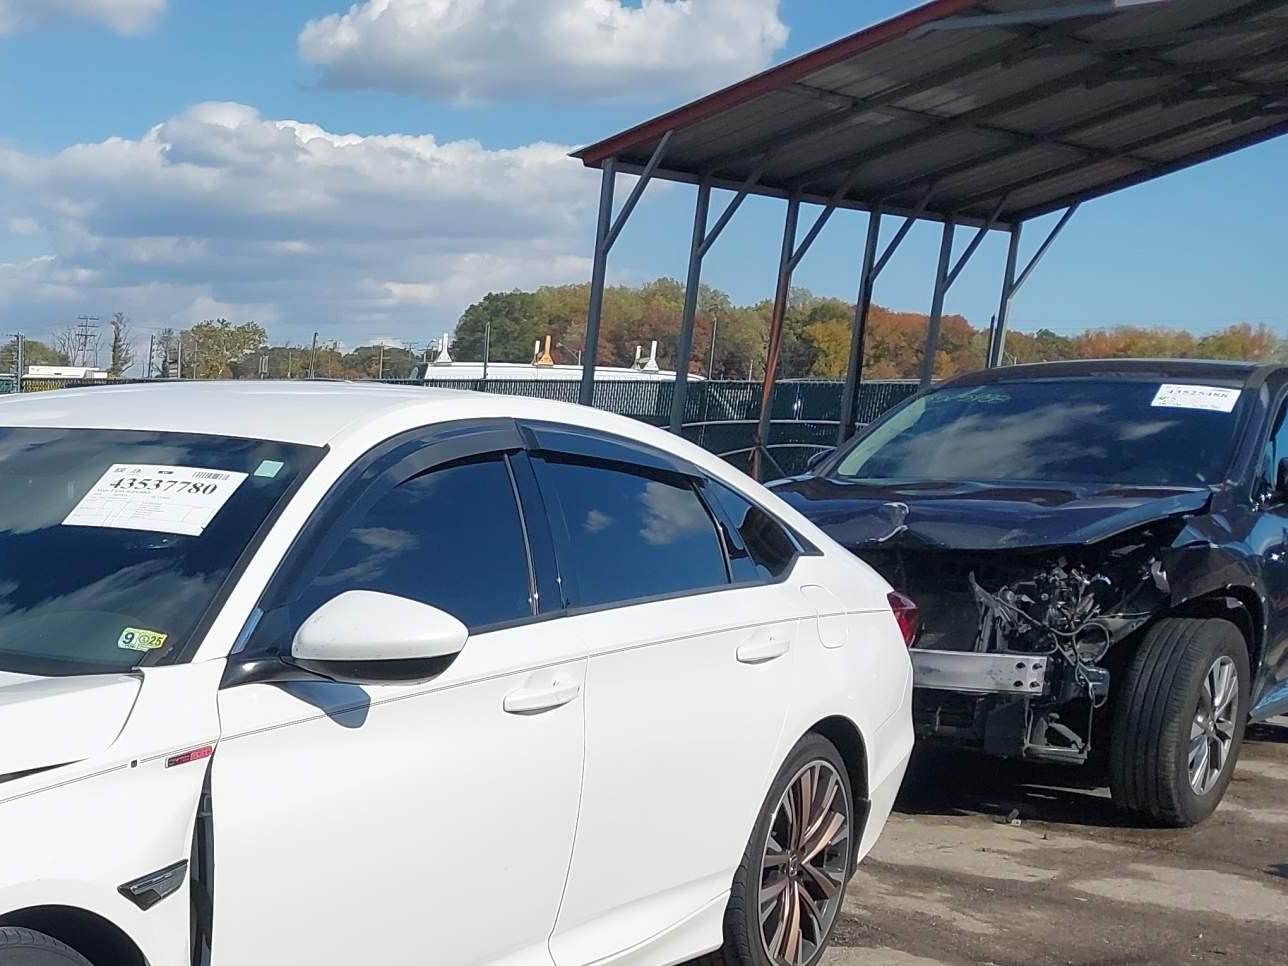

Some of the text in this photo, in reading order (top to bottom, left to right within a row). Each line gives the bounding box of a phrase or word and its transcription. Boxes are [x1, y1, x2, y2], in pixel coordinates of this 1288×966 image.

[109, 477, 218, 496] 43537780
[122, 632, 135, 644] 9
[149, 635, 163, 646] 25
